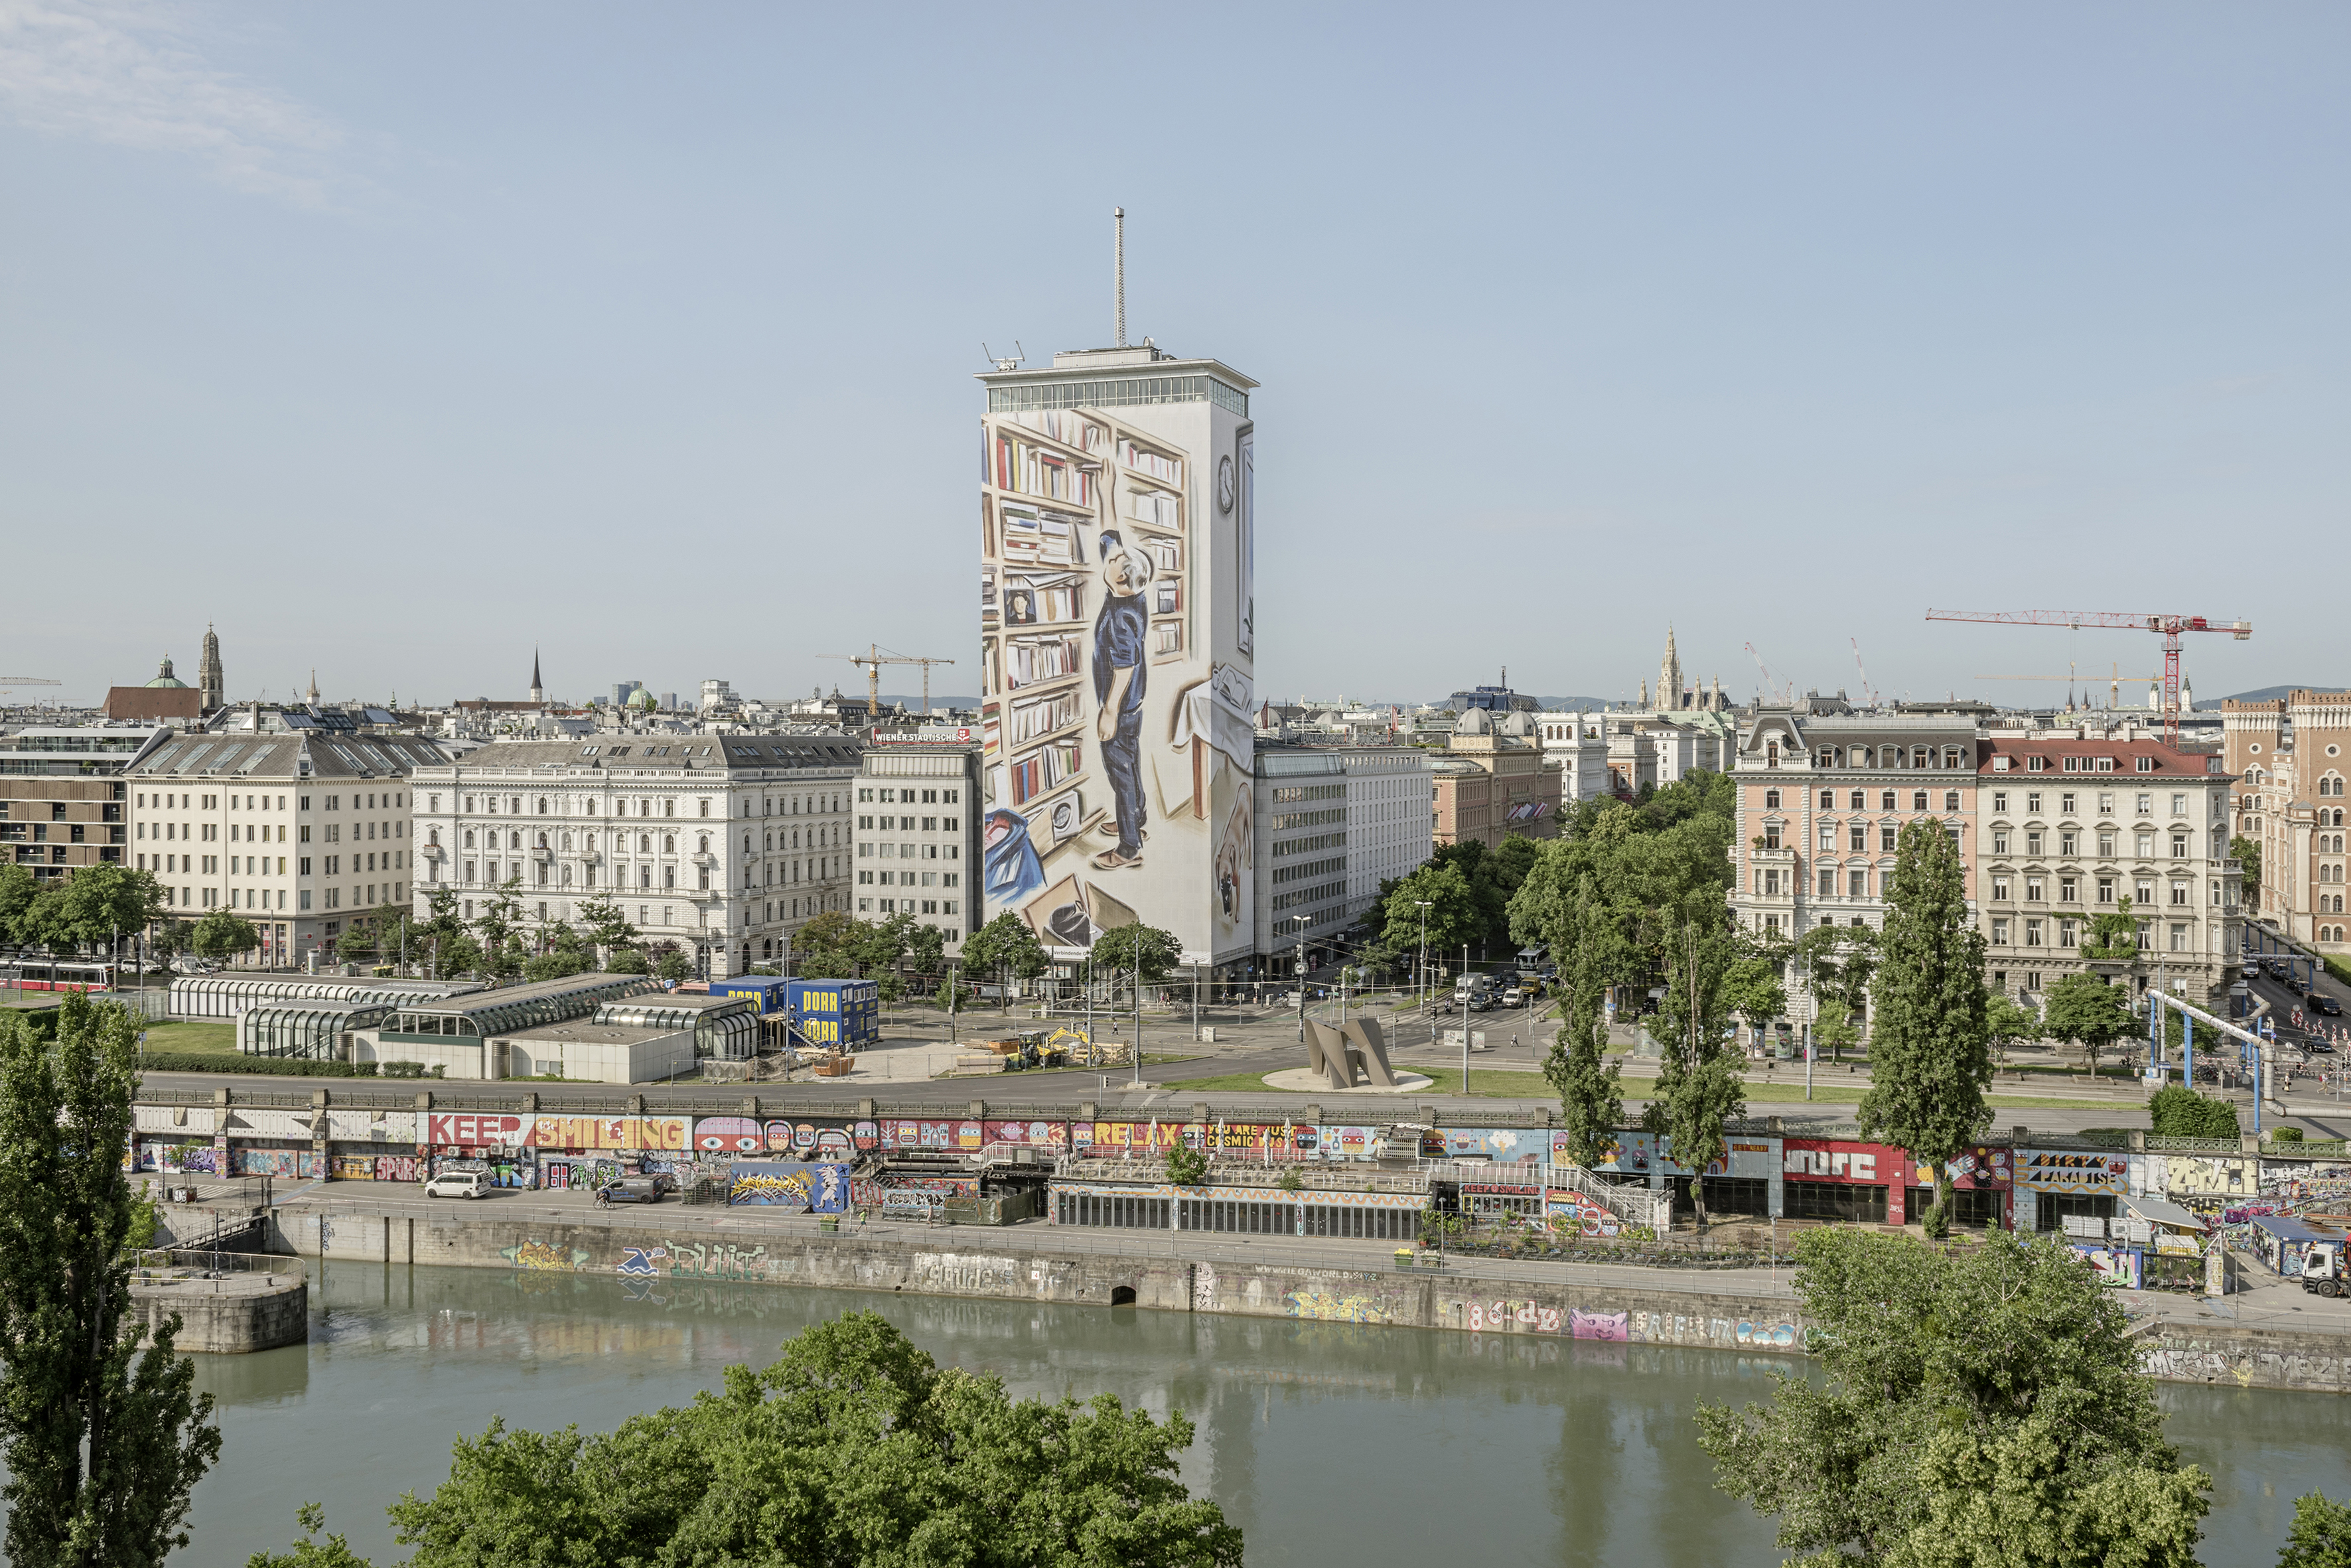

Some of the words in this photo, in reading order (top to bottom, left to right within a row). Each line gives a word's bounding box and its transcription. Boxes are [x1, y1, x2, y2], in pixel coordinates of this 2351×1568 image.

[804, 991, 837, 1013] PORR
[804, 1020, 838, 1042] PORR
[429, 1115, 521, 1146] KEEP
[534, 1117, 684, 1150] SMILING
[1095, 1123, 1178, 1145] RELAX
[1235, 1125, 1257, 1135] ARE
[2040, 1153, 2107, 1169] DIRTY
[2040, 1170, 2117, 1185] PARADISE
[1464, 1184, 1490, 1193] KEEP
[1500, 1185, 1541, 1194] SMILING
